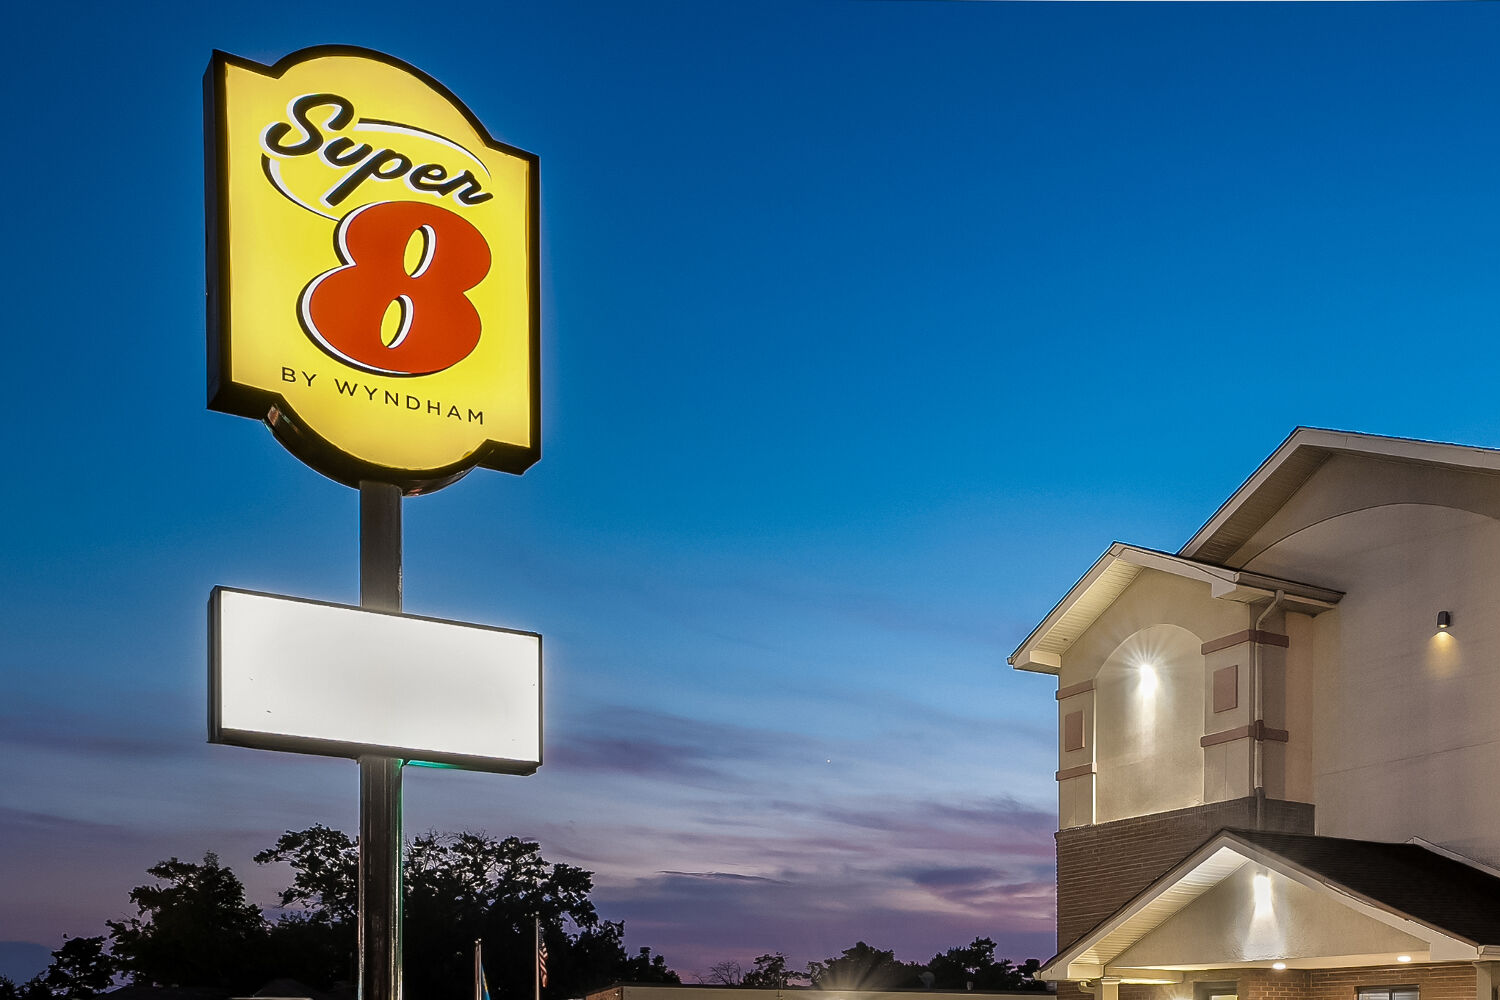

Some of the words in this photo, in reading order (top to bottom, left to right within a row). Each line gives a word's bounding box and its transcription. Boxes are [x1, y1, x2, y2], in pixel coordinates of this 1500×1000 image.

[264, 93, 494, 207] Super
[296, 201, 492, 377] 8
[281, 367, 317, 387] BY
[335, 379, 485, 425] WYNDHAM
